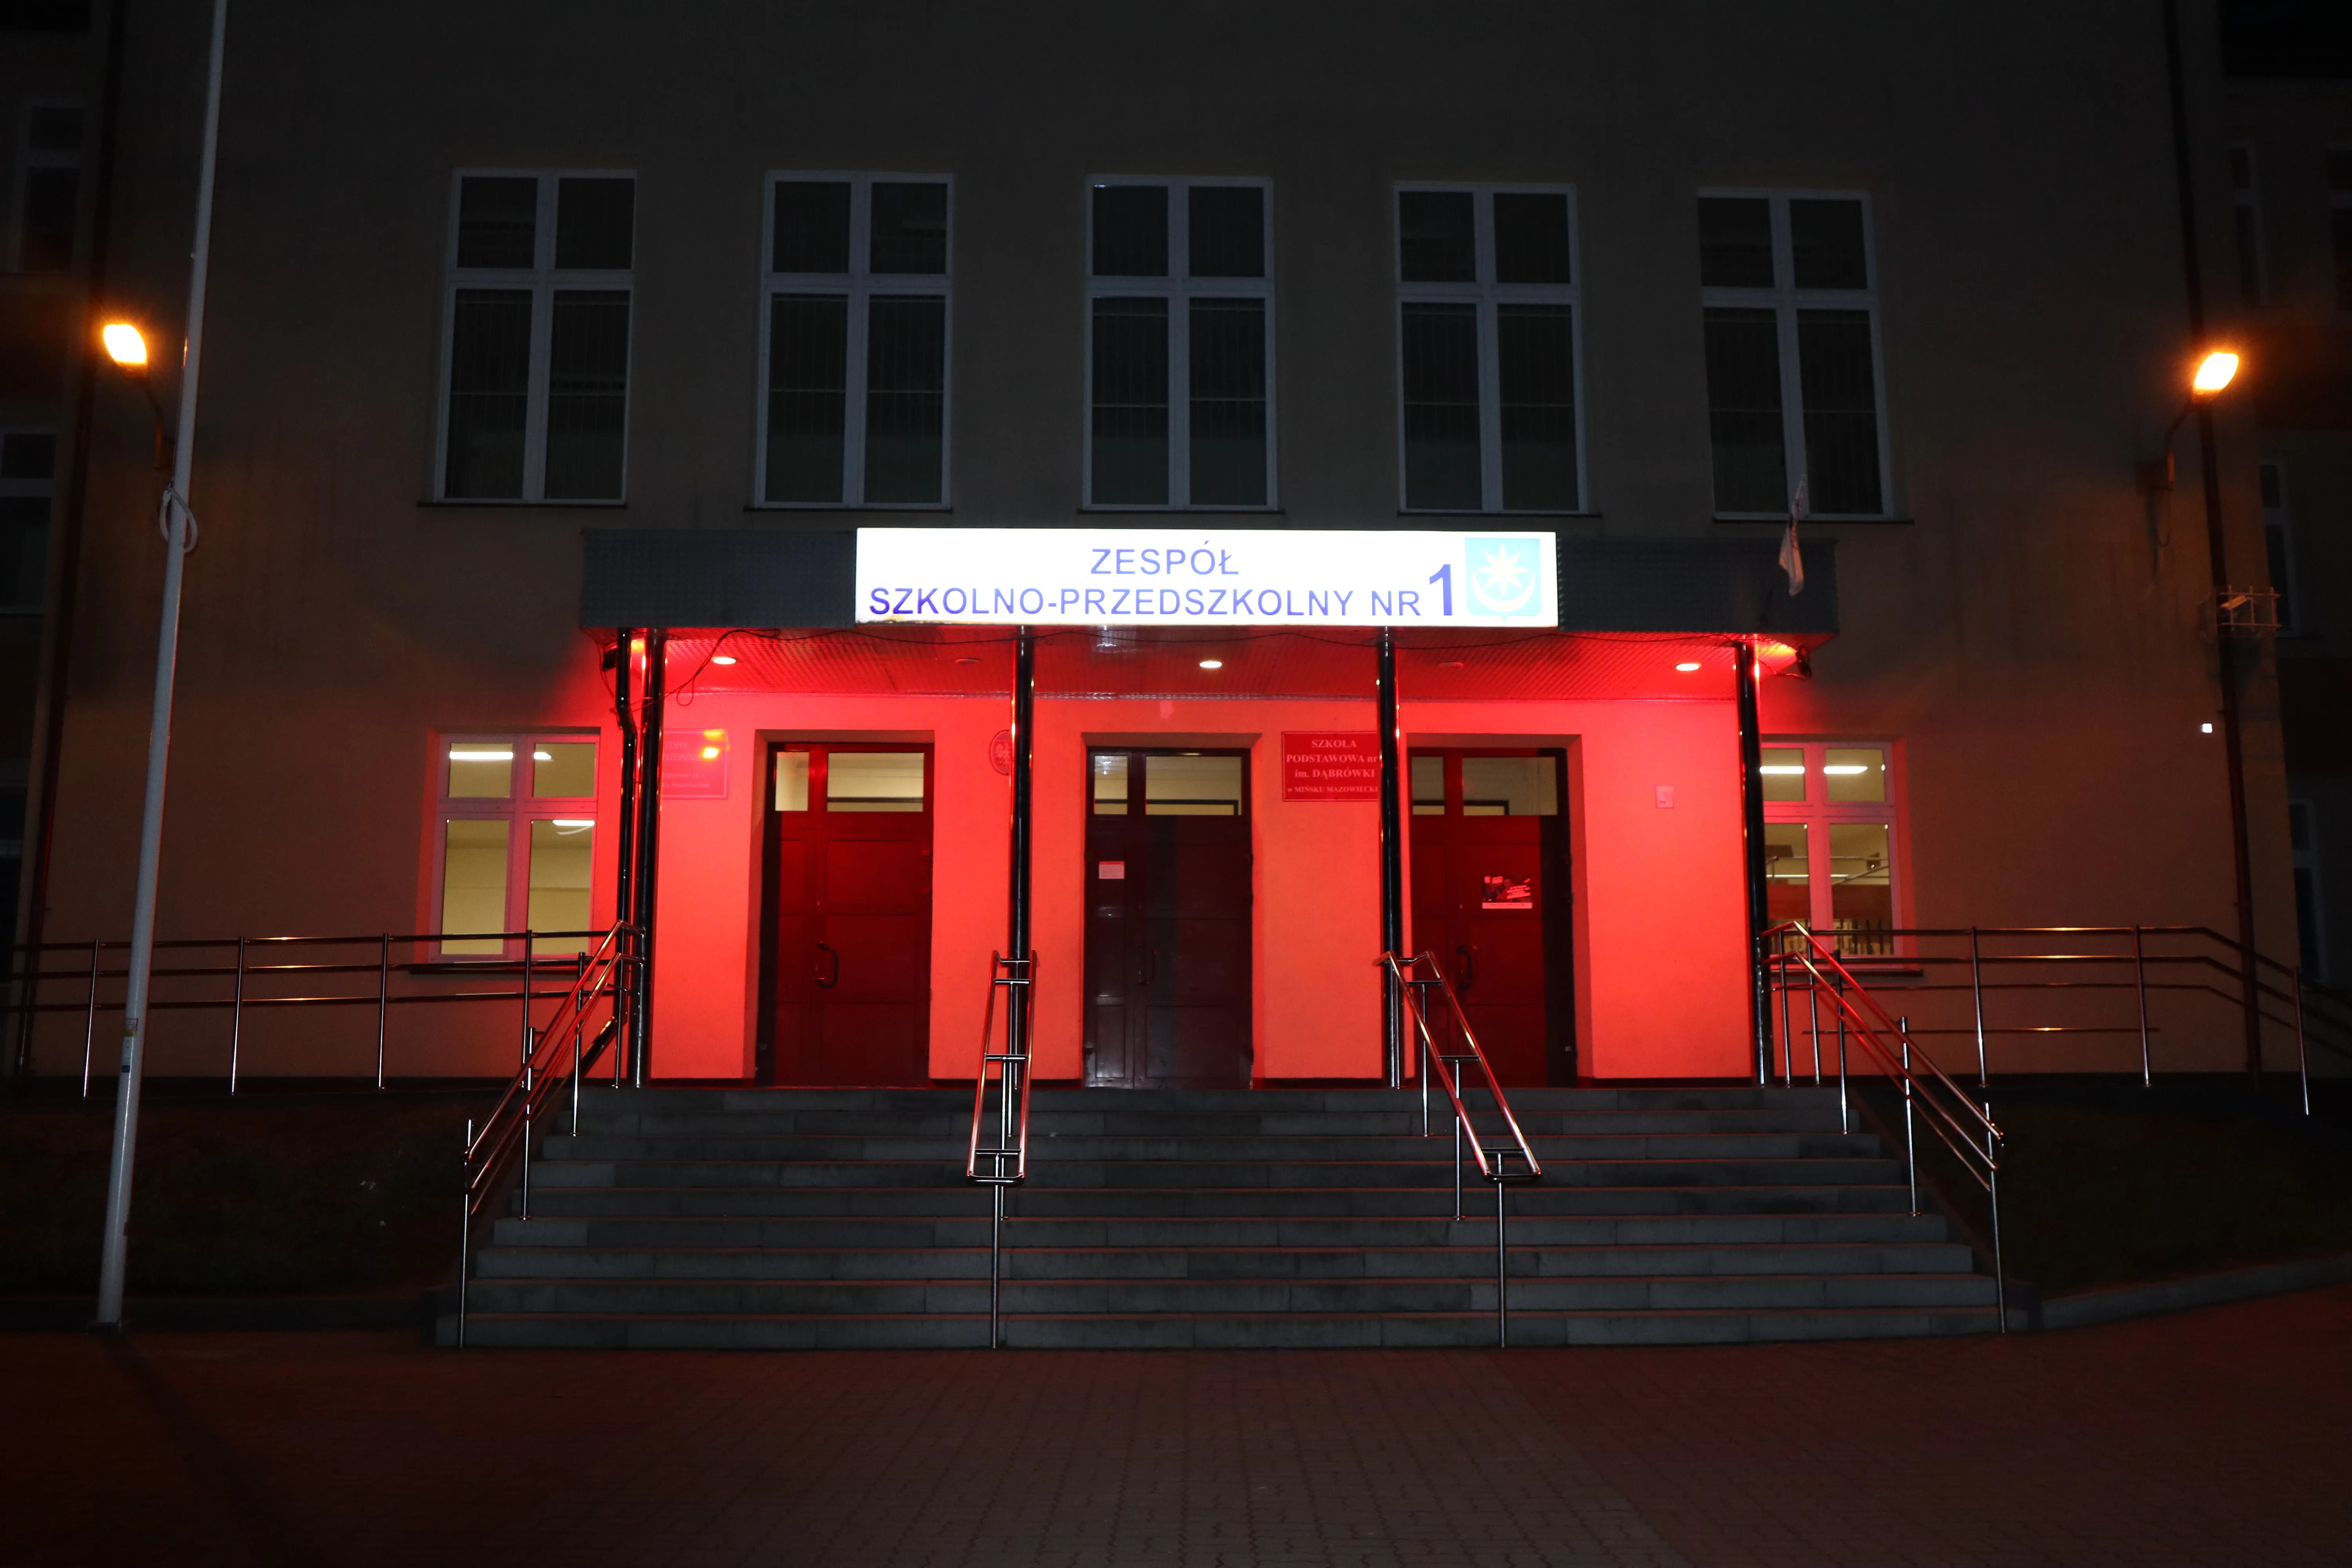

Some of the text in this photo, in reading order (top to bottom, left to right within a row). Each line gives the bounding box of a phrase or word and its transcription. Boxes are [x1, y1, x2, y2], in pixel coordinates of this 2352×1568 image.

[1091, 540, 1239, 575] ZESPÓŁ
[869, 564, 1453, 616] SZKOLNO-PRZEDSZKOLNY NR 1
[1311, 740, 1357, 748] SZKOŁA
[1287, 754, 1365, 762] PODSTAWOWA
[1295, 767, 1375, 779] im. DĄBRÓWKI
